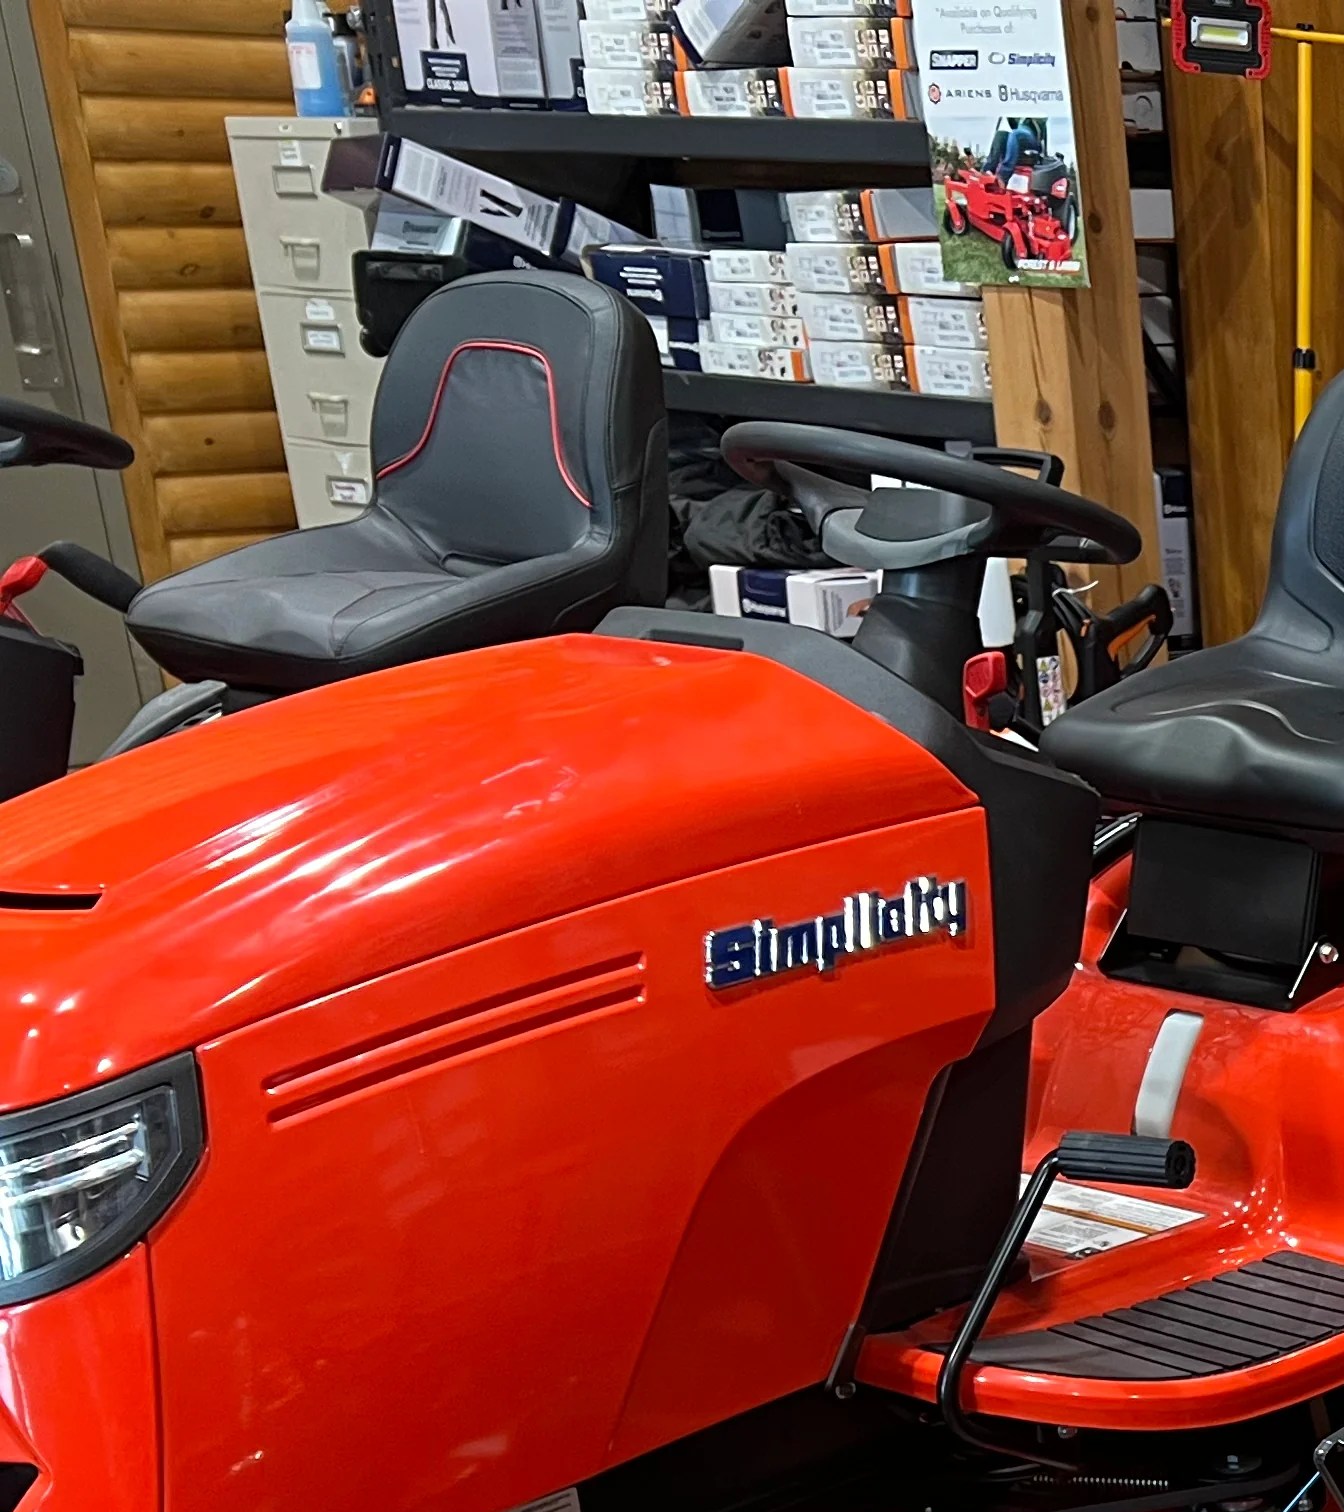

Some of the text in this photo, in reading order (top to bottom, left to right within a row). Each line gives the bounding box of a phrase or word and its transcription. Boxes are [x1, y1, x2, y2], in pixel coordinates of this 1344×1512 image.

[1008, 53, 1055, 67] Simplicity
[945, 89, 992, 99] ARIENS
[1009, 88, 1064, 103] Husqvarna
[704, 876, 967, 988] Simplicity
